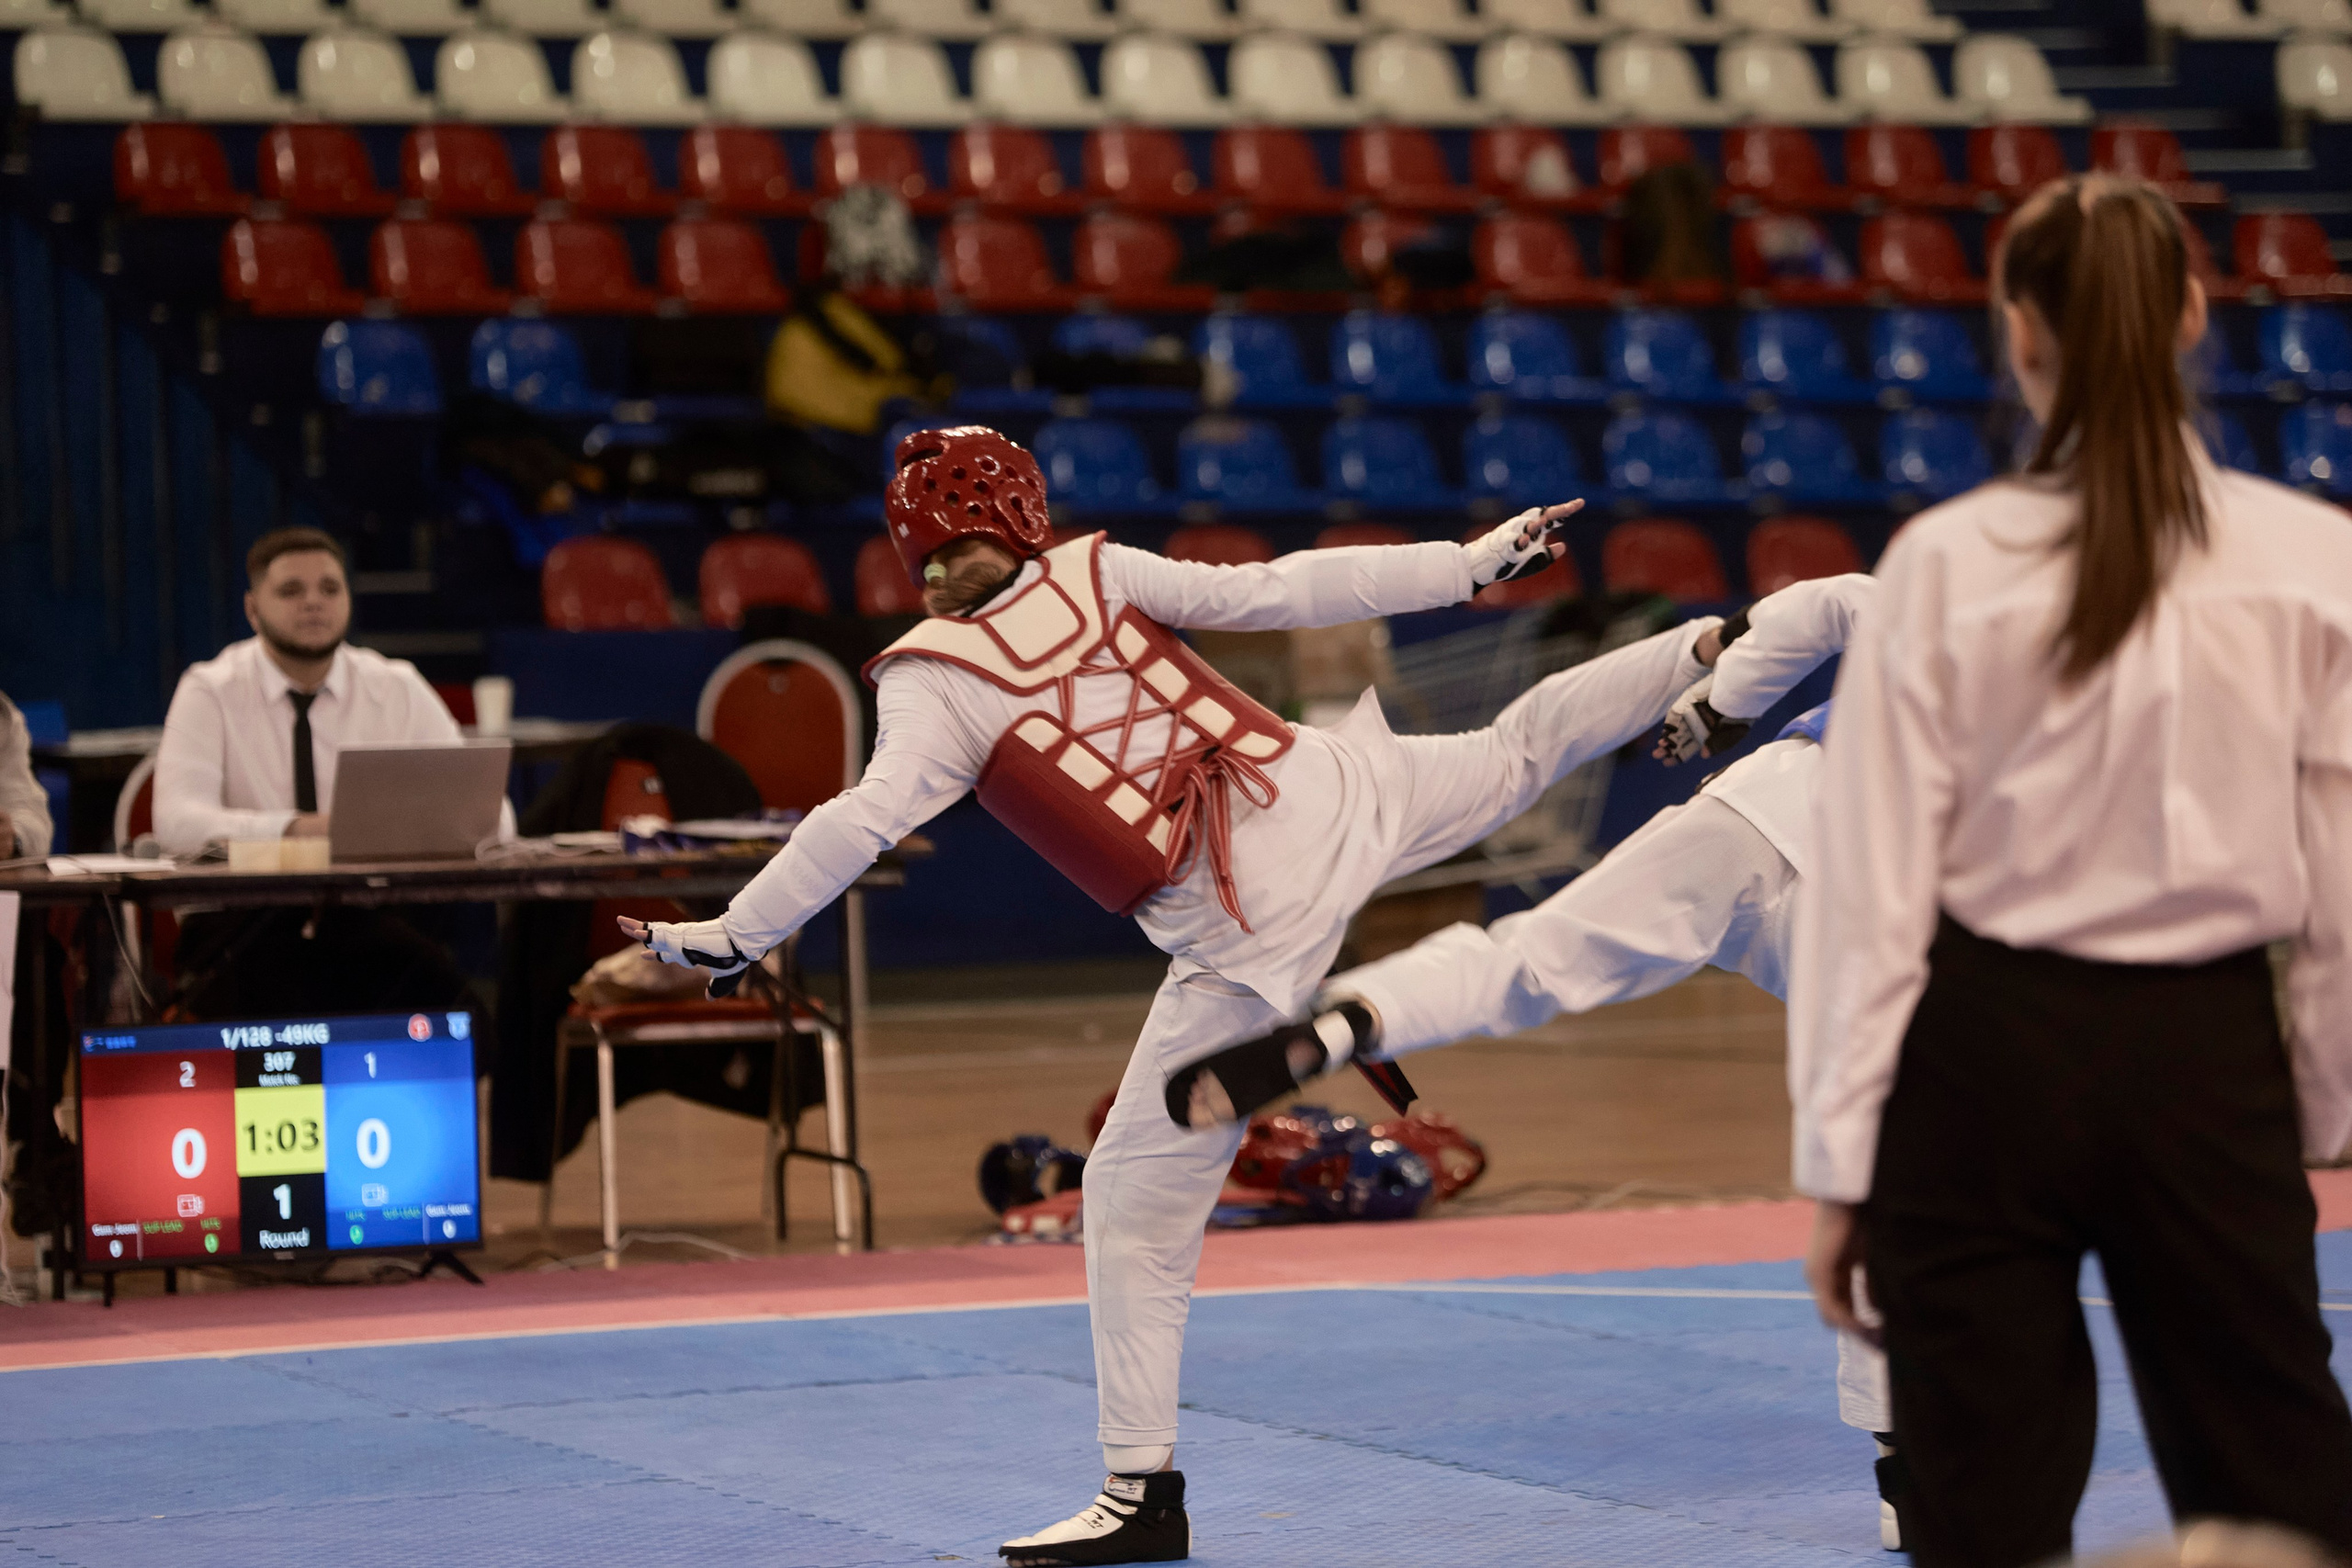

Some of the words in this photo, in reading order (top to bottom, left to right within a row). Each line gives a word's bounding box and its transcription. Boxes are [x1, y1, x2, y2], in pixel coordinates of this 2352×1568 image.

[220, 1027, 273, 1050] 1/128
[275, 1023, 330, 1044] -49KG
[179, 1061, 196, 1088] 2
[264, 1051, 296, 1072] 307
[364, 1052, 377, 1078] 1
[244, 1120, 320, 1155] 1:03
[356, 1118, 391, 1169] 0
[172, 1128, 207, 1179] 0
[273, 1183, 292, 1220] 1
[259, 1227, 311, 1249] Round
